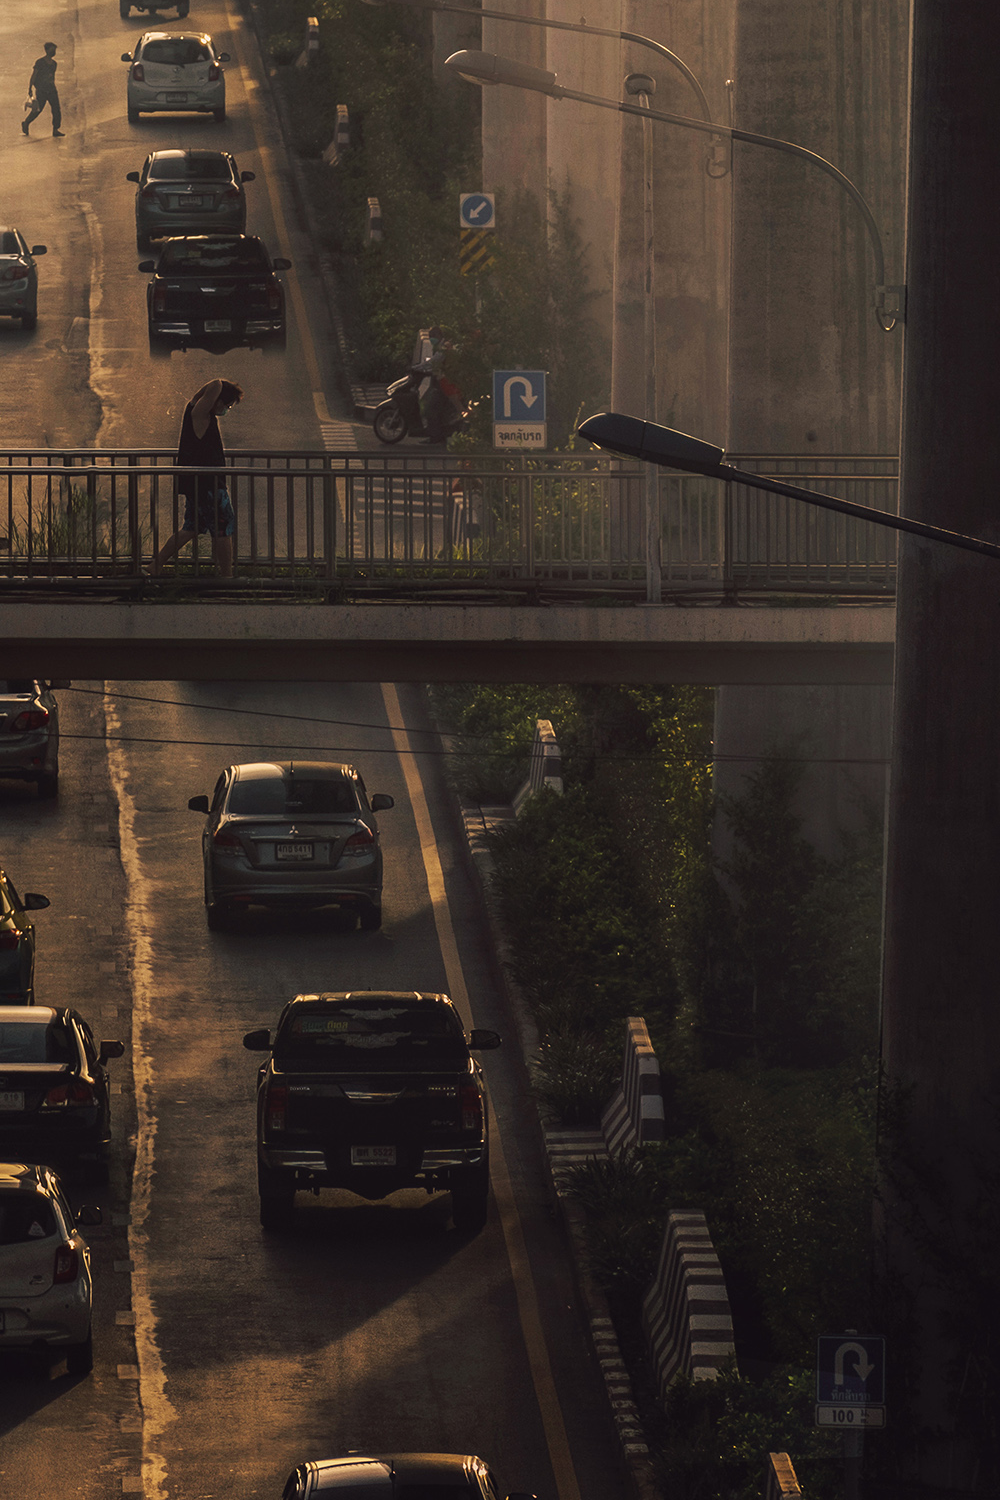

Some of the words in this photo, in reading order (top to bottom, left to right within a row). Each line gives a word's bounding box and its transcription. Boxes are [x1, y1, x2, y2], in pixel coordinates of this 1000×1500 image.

[498, 429, 542, 445] จุดกลับรถ
[832, 1410, 854, 1423] 100
